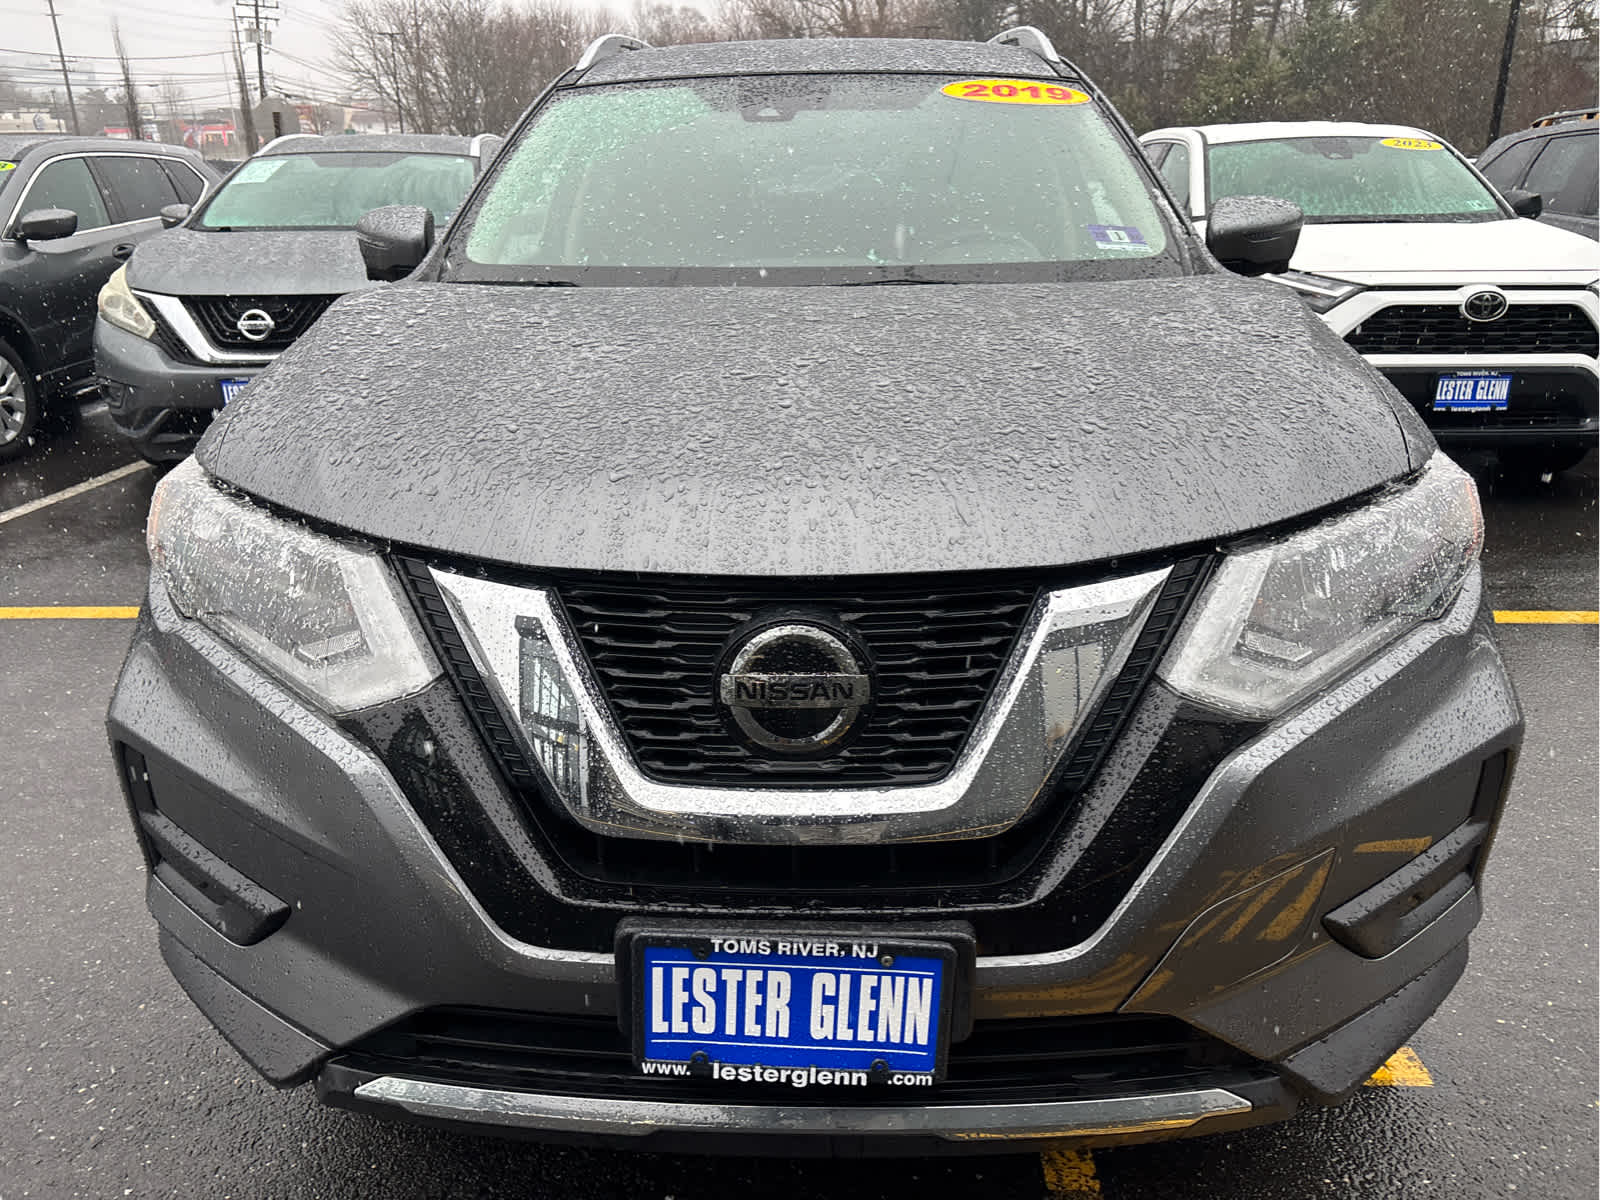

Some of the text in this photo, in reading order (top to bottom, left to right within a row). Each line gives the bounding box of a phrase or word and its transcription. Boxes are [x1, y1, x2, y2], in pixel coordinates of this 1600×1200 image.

[962, 84, 1073, 100] 2019
[1435, 380, 1510, 400] LESTER GLENN
[735, 682, 854, 700] NISSAN
[710, 939, 879, 958] TOMS RIVER, NJ
[651, 966, 934, 1046] LESTER GLENN
[641, 1061, 933, 1088] www. lesterglenn .com
